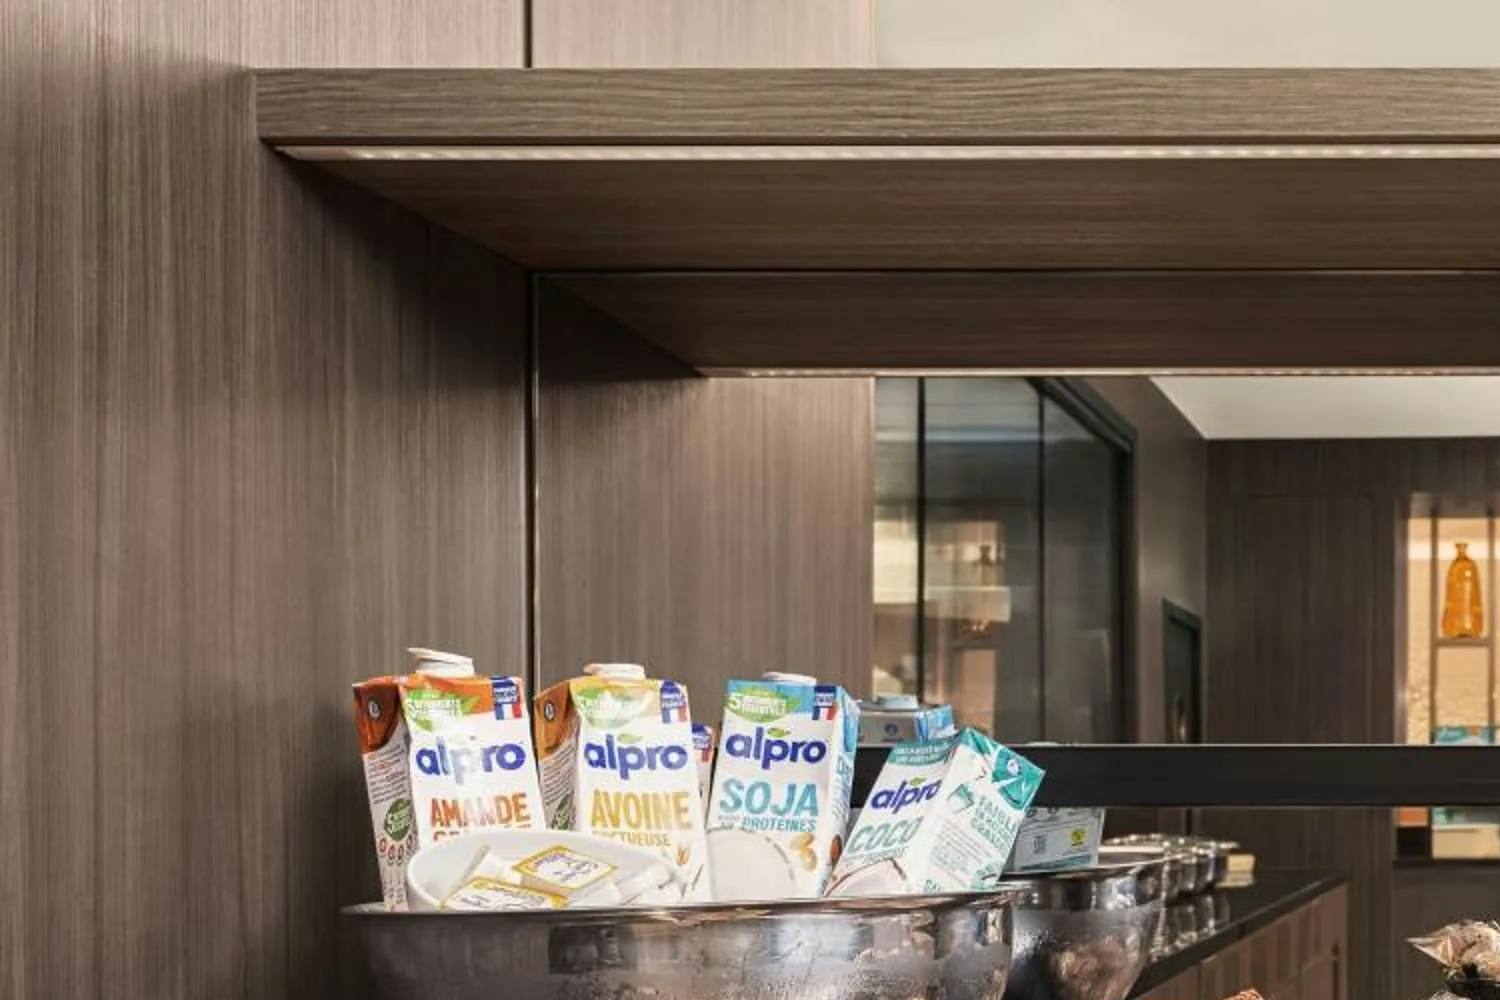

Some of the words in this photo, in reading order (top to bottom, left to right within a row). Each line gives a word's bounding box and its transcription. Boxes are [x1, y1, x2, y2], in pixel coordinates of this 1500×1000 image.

[415, 735, 526, 785] alpro
[584, 733, 689, 781] alpro
[725, 726, 828, 770] alpro
[431, 791, 532, 829] AMANDE
[591, 788, 693, 831] AVOINE
[719, 777, 819, 817] SOJA
[870, 779, 943, 814] alpro
[847, 816, 925, 854] COCO
